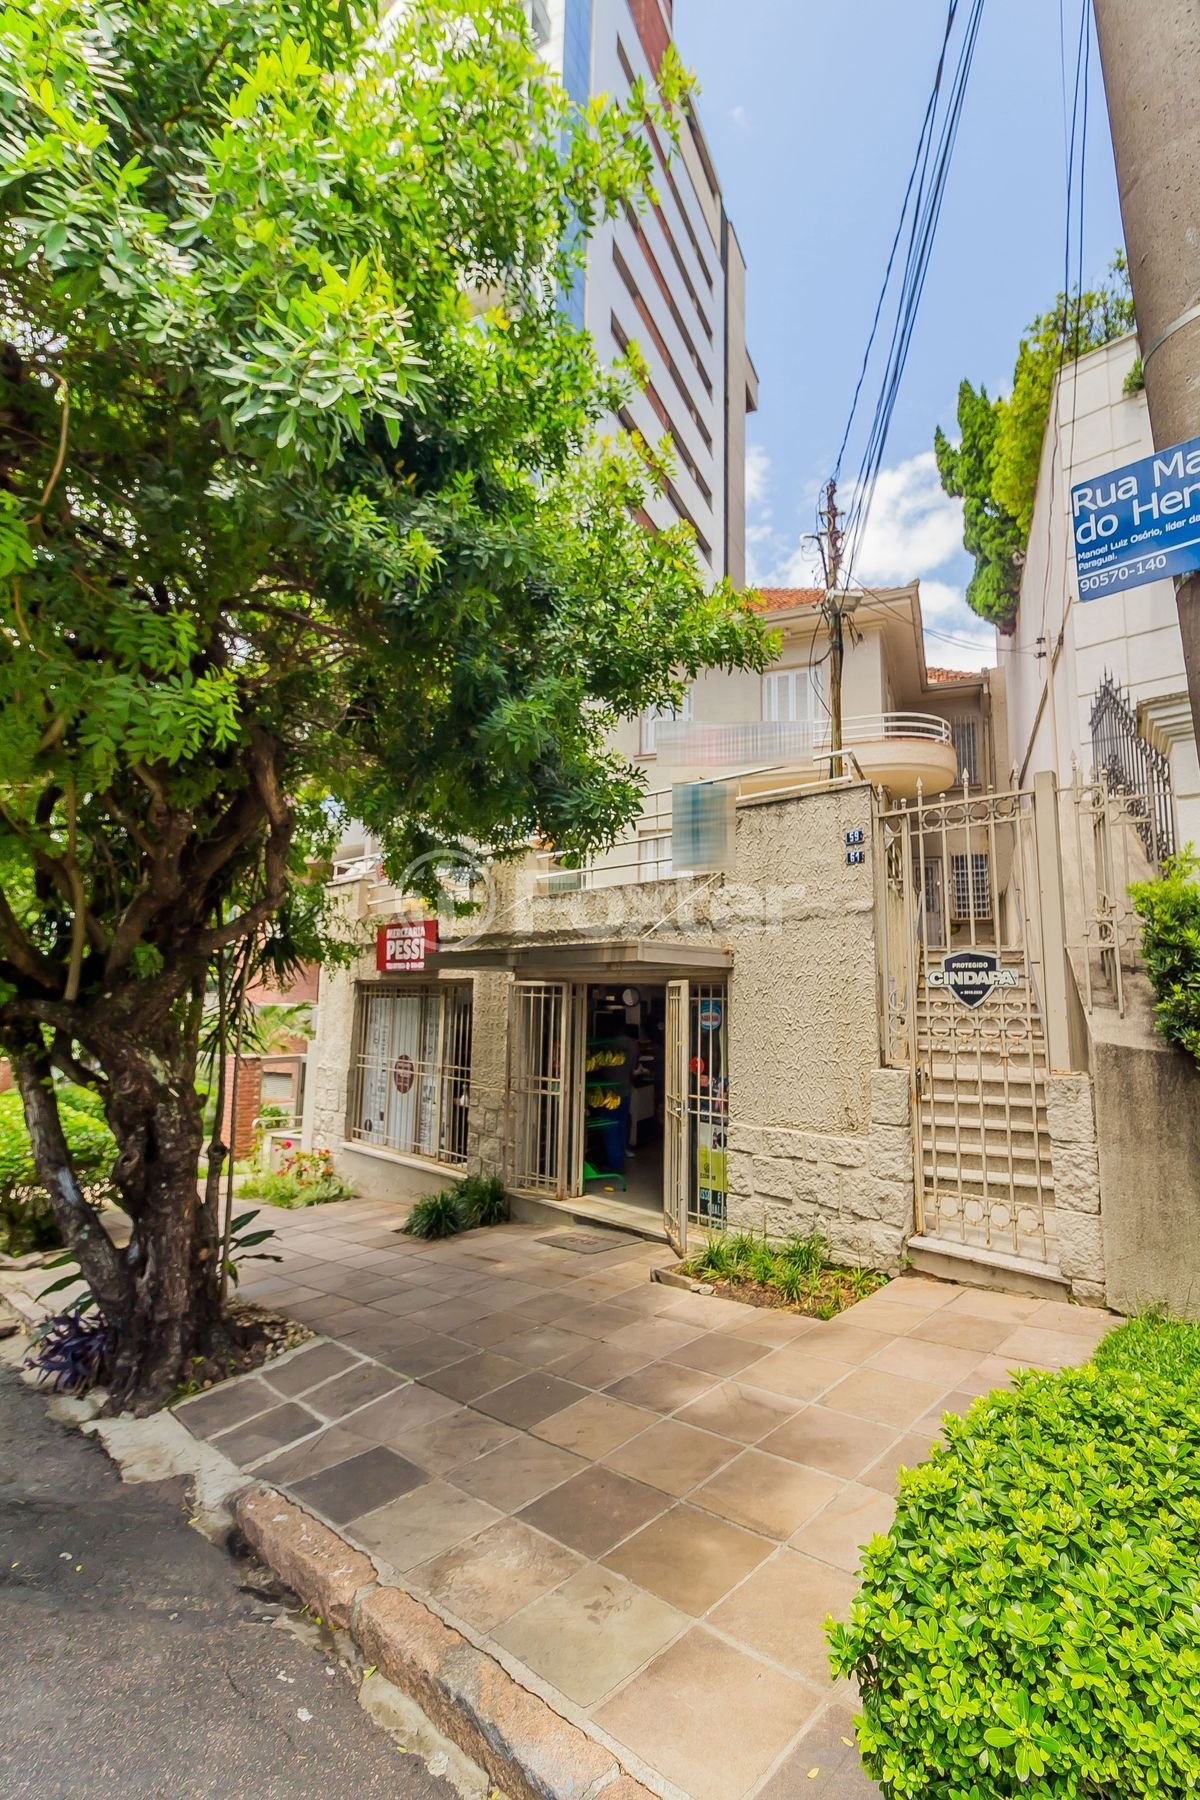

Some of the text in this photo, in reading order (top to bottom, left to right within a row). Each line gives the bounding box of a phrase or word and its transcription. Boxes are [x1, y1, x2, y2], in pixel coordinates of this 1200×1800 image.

[1073, 476, 1138, 517] Rua
[1076, 513, 1119, 545] do
[1077, 544, 1108, 562] Manoel
[1110, 538, 1129, 551] Luiz
[1080, 555, 1167, 592] 90570-140
[849, 831, 860, 842] 59
[850, 852, 861, 863] 61
[386, 938, 425, 960] PESSI
[952, 961, 988, 969] PROTEGIDO
[929, 970, 1016, 985] CINDAPA
